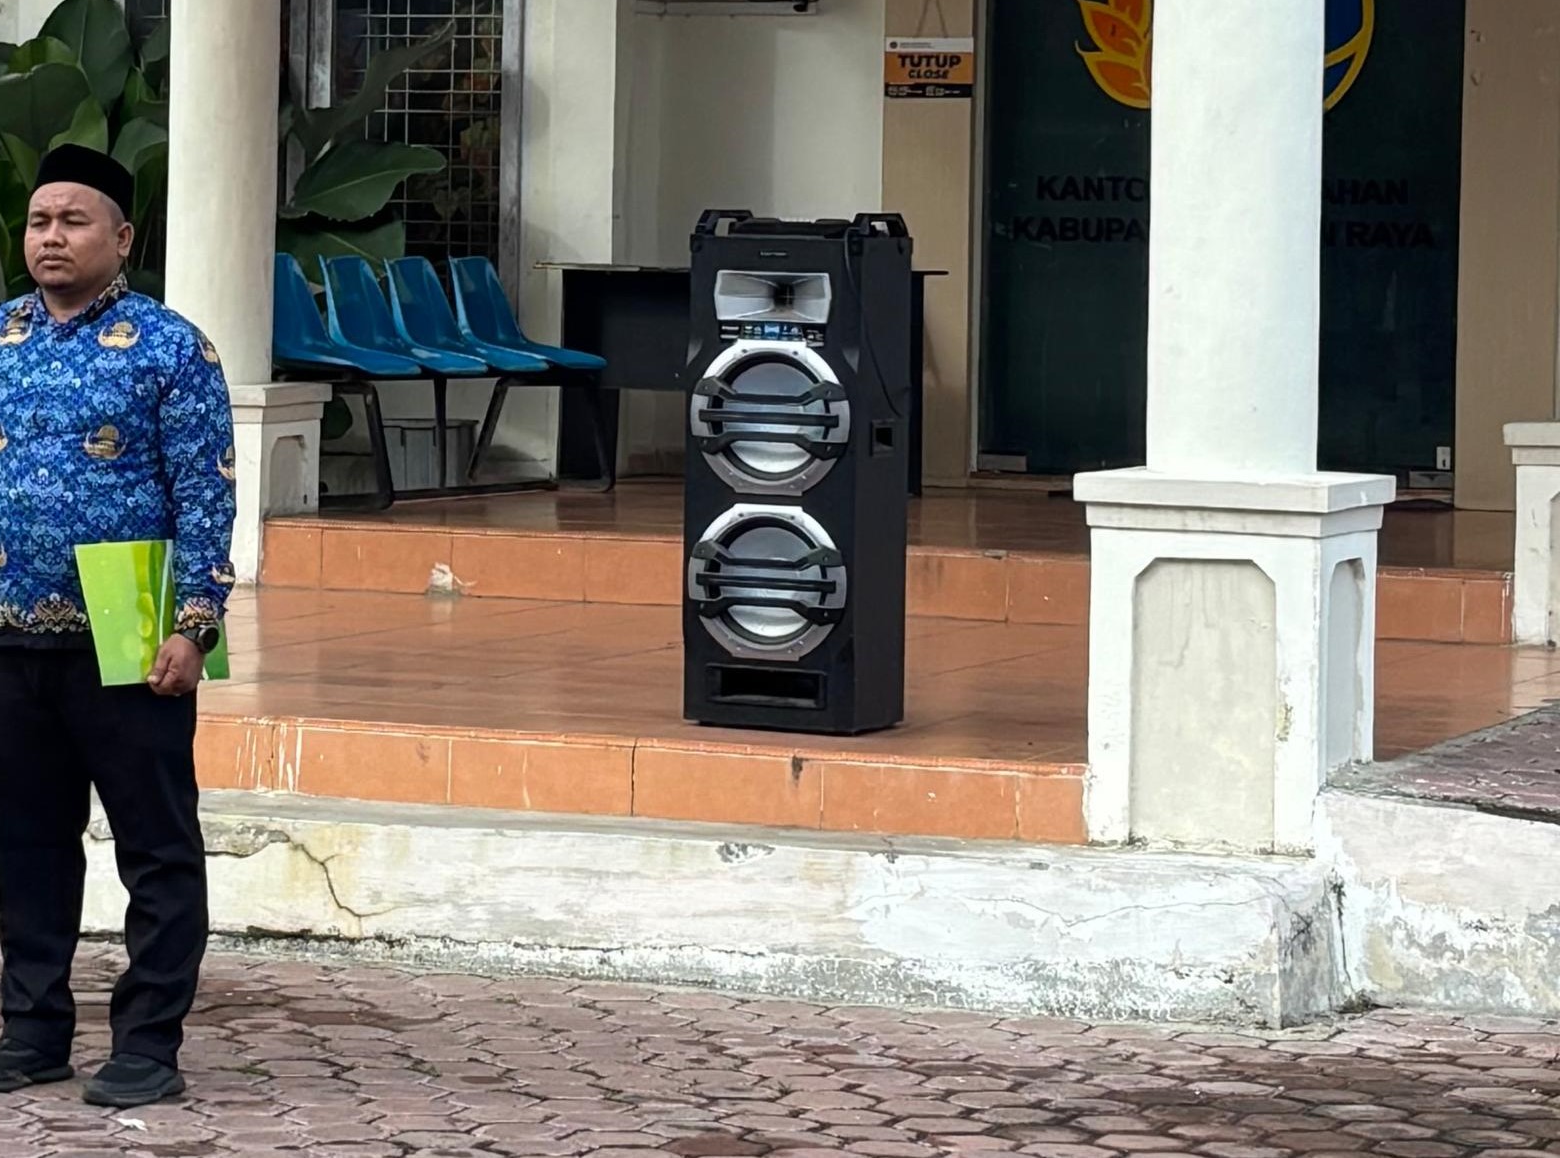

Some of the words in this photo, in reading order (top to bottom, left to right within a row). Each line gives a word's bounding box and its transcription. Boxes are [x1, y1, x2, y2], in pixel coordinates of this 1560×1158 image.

[898, 54, 962, 68] TUTUP
[908, 68, 950, 79] CLOSE
[1037, 176, 1145, 202] KANTO
[1012, 216, 1145, 242] KABUPA
[1346, 221, 1435, 249] RAYA
